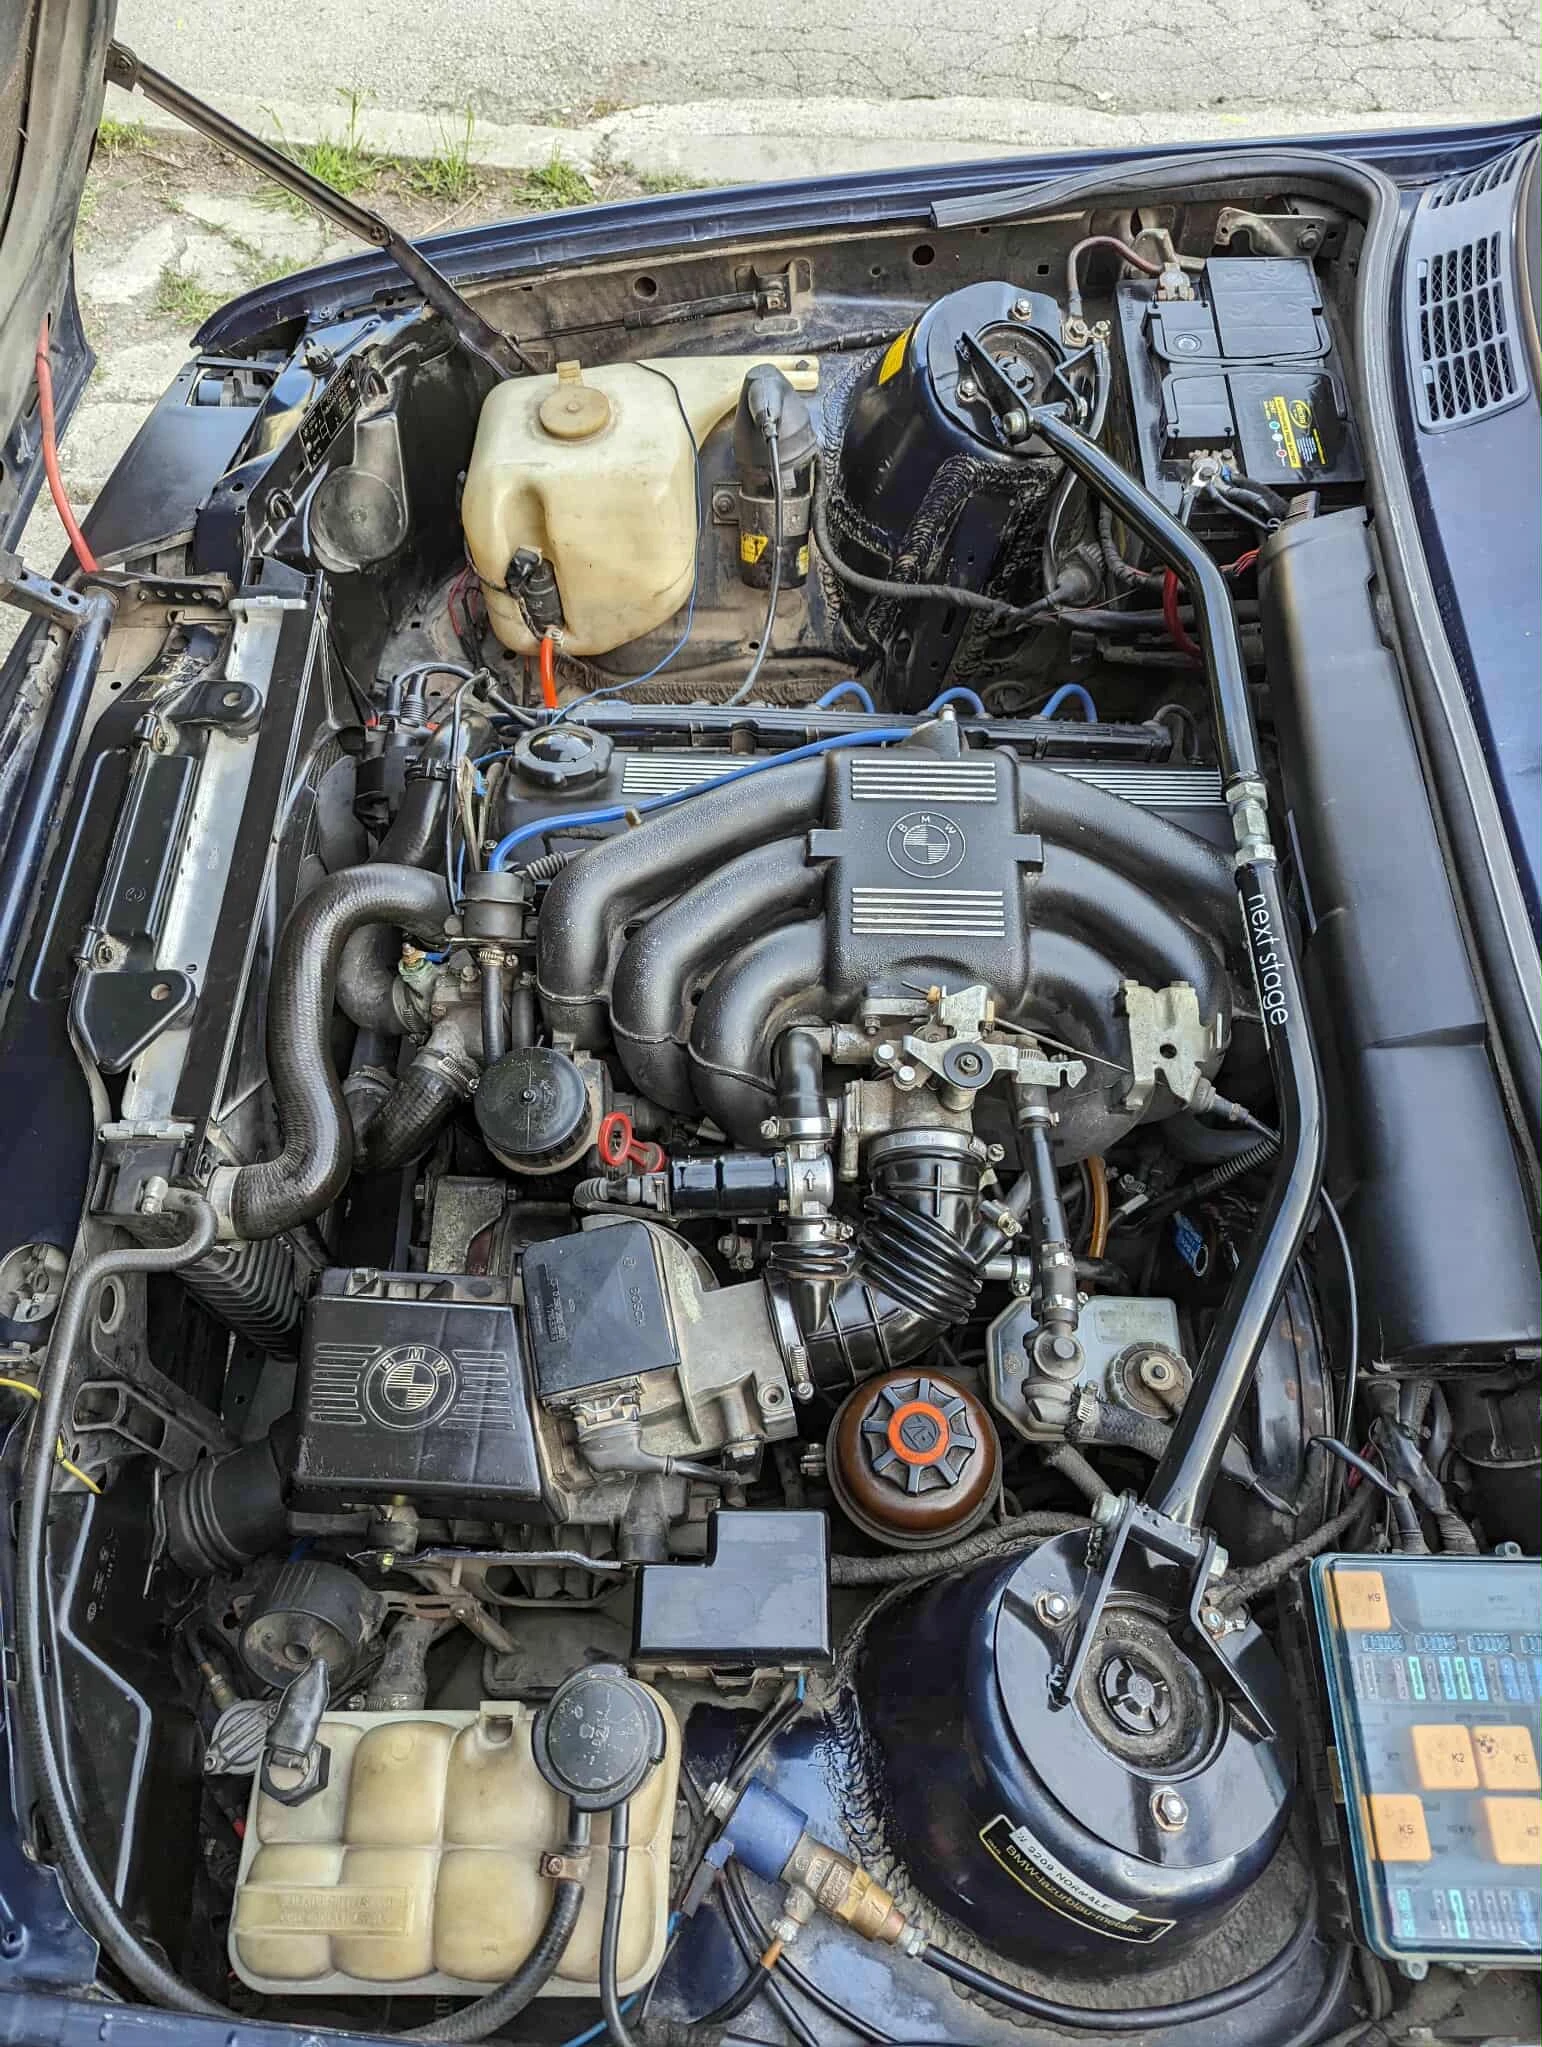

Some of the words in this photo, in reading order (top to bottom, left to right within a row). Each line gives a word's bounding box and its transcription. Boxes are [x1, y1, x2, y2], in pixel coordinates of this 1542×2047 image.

[897, 815, 957, 834] BMW
[1248, 893, 1280, 946] next
[1259, 952, 1289, 1025] stage
[380, 1346, 450, 1376] BMW
[1451, 1752, 1465, 1763] K2
[1399, 1824, 1415, 1835] K5
[1056, 1872, 1114, 1911] NORMALE
